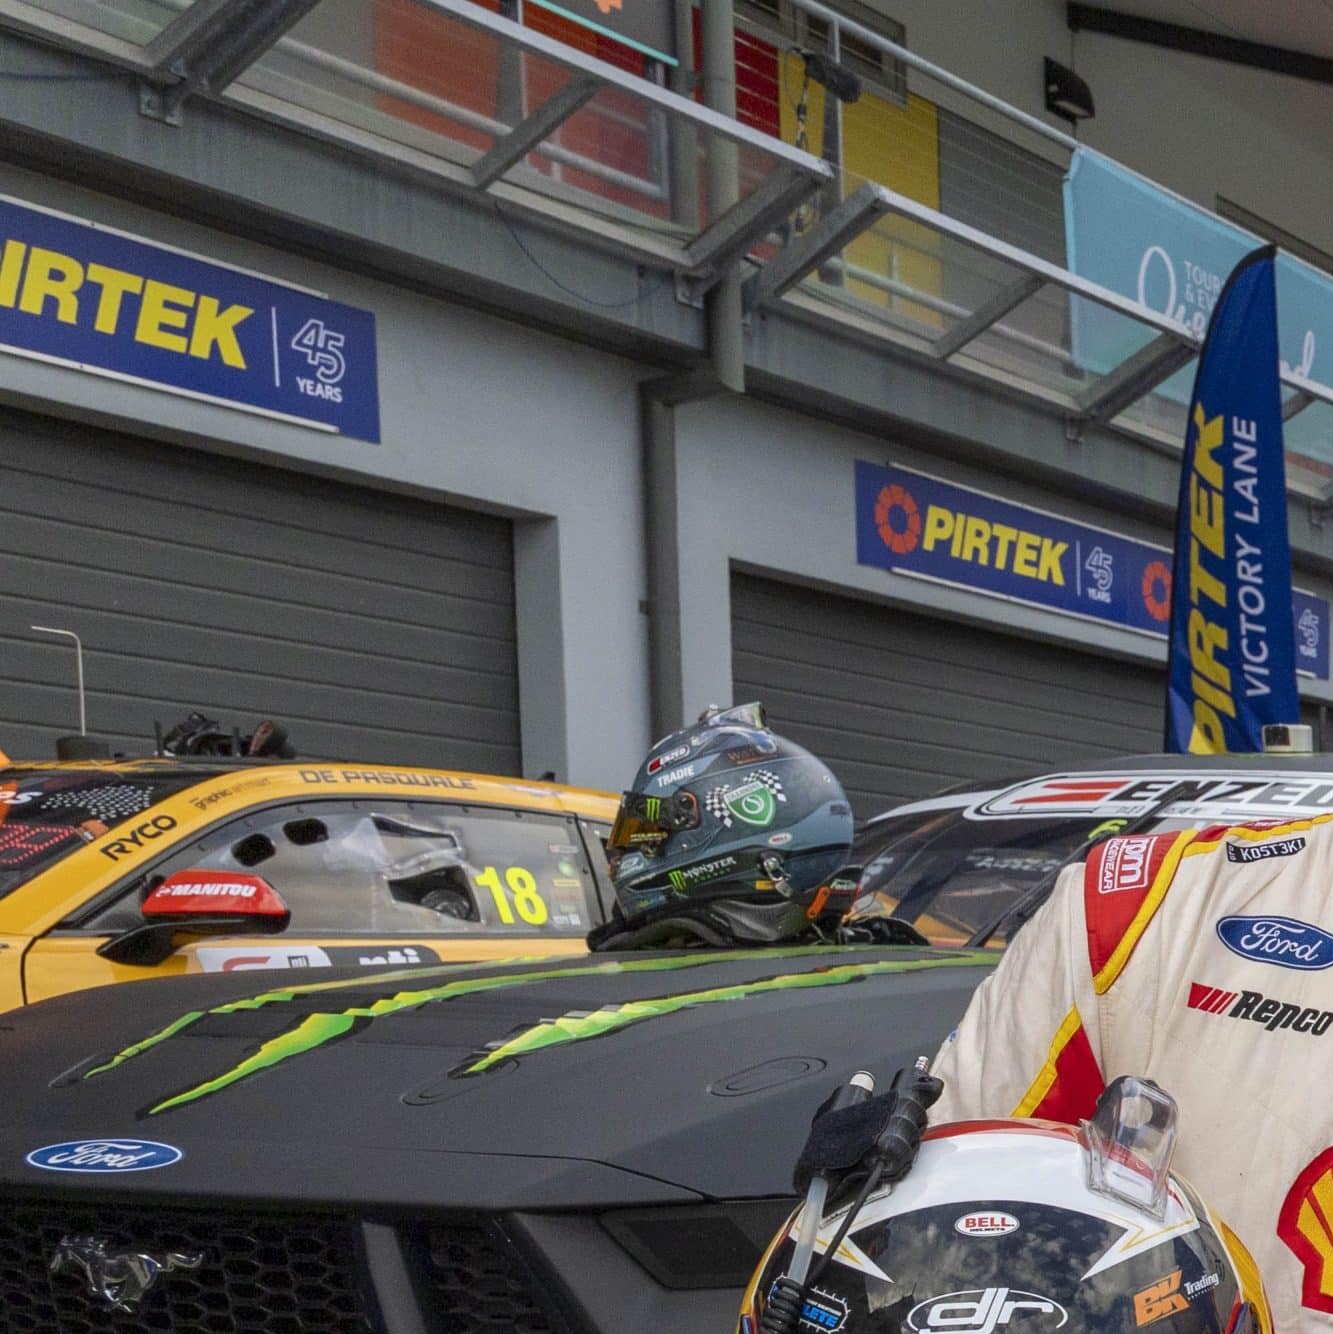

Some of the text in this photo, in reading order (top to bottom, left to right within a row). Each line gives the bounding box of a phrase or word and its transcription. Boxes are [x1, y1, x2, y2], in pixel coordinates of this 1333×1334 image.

[291, 319, 346, 384] 45
[296, 376, 344, 402] YEARS
[923, 504, 1070, 587] PIRTEK
[1231, 416, 1271, 697] VICTORY LANE
[299, 769, 476, 790] DE PASQUALE
[657, 764, 695, 788] TRADIE
[100, 815, 178, 861] RYCO
[1240, 839, 1304, 861] KOST3KI
[171, 883, 257, 897] MANITOU
[474, 866, 549, 925] 18
[1239, 920, 1324, 962] Ford
[47, 1142, 158, 1169] Ford
[965, 1217, 1010, 1228] BELL
[1184, 1272, 1219, 1296] Trading
